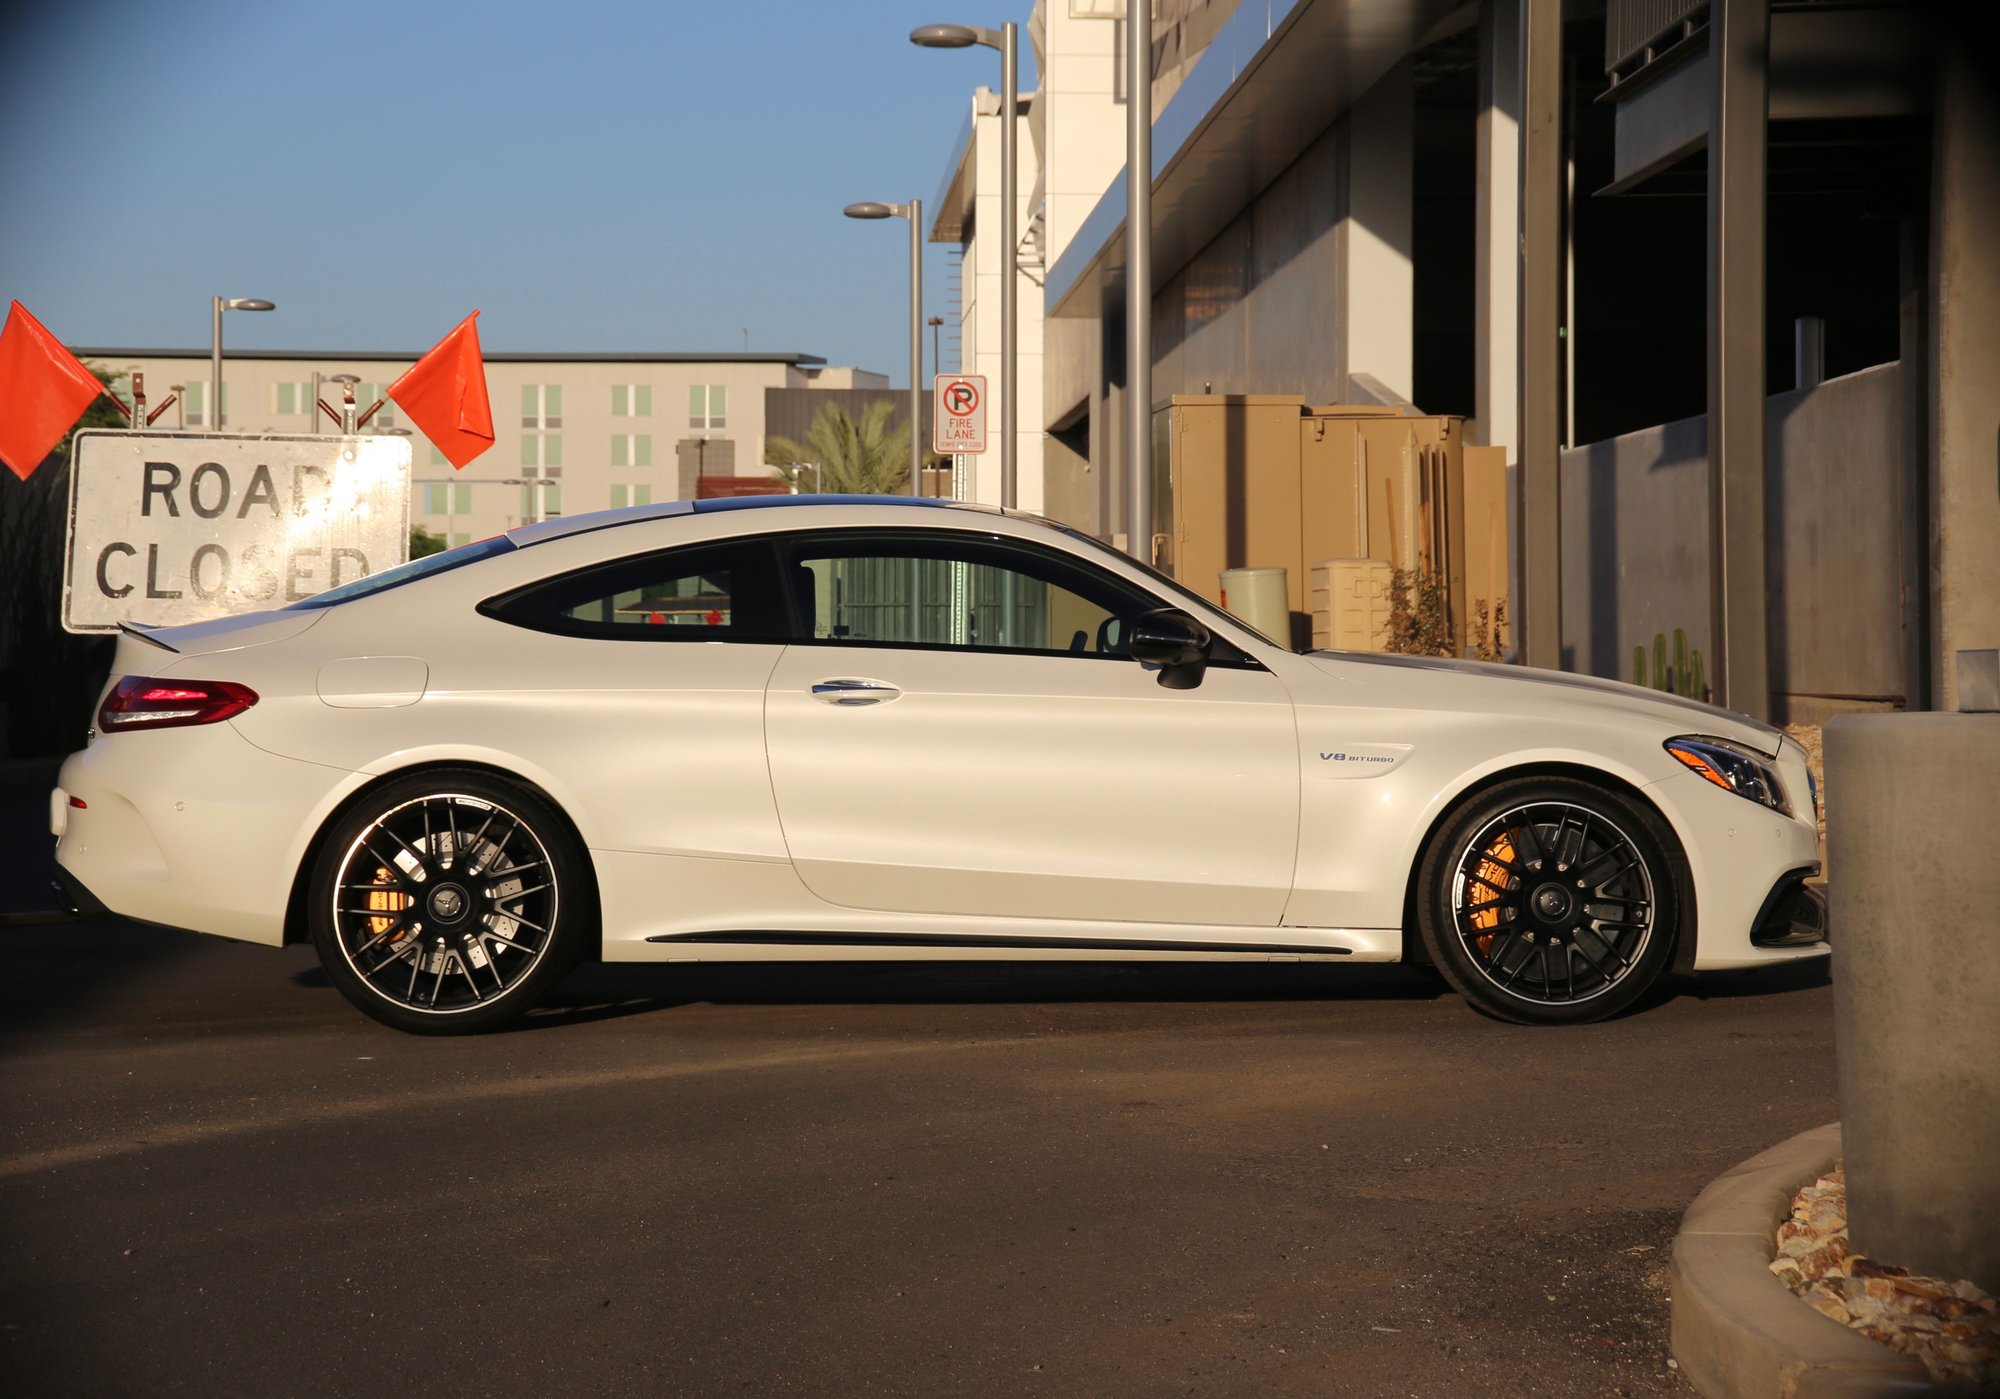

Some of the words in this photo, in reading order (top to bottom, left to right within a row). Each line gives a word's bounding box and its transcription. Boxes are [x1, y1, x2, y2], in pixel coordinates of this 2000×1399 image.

[949, 418, 973, 428] FIRE
[946, 429, 975, 439] LANE
[1319, 752, 1346, 761] V8
